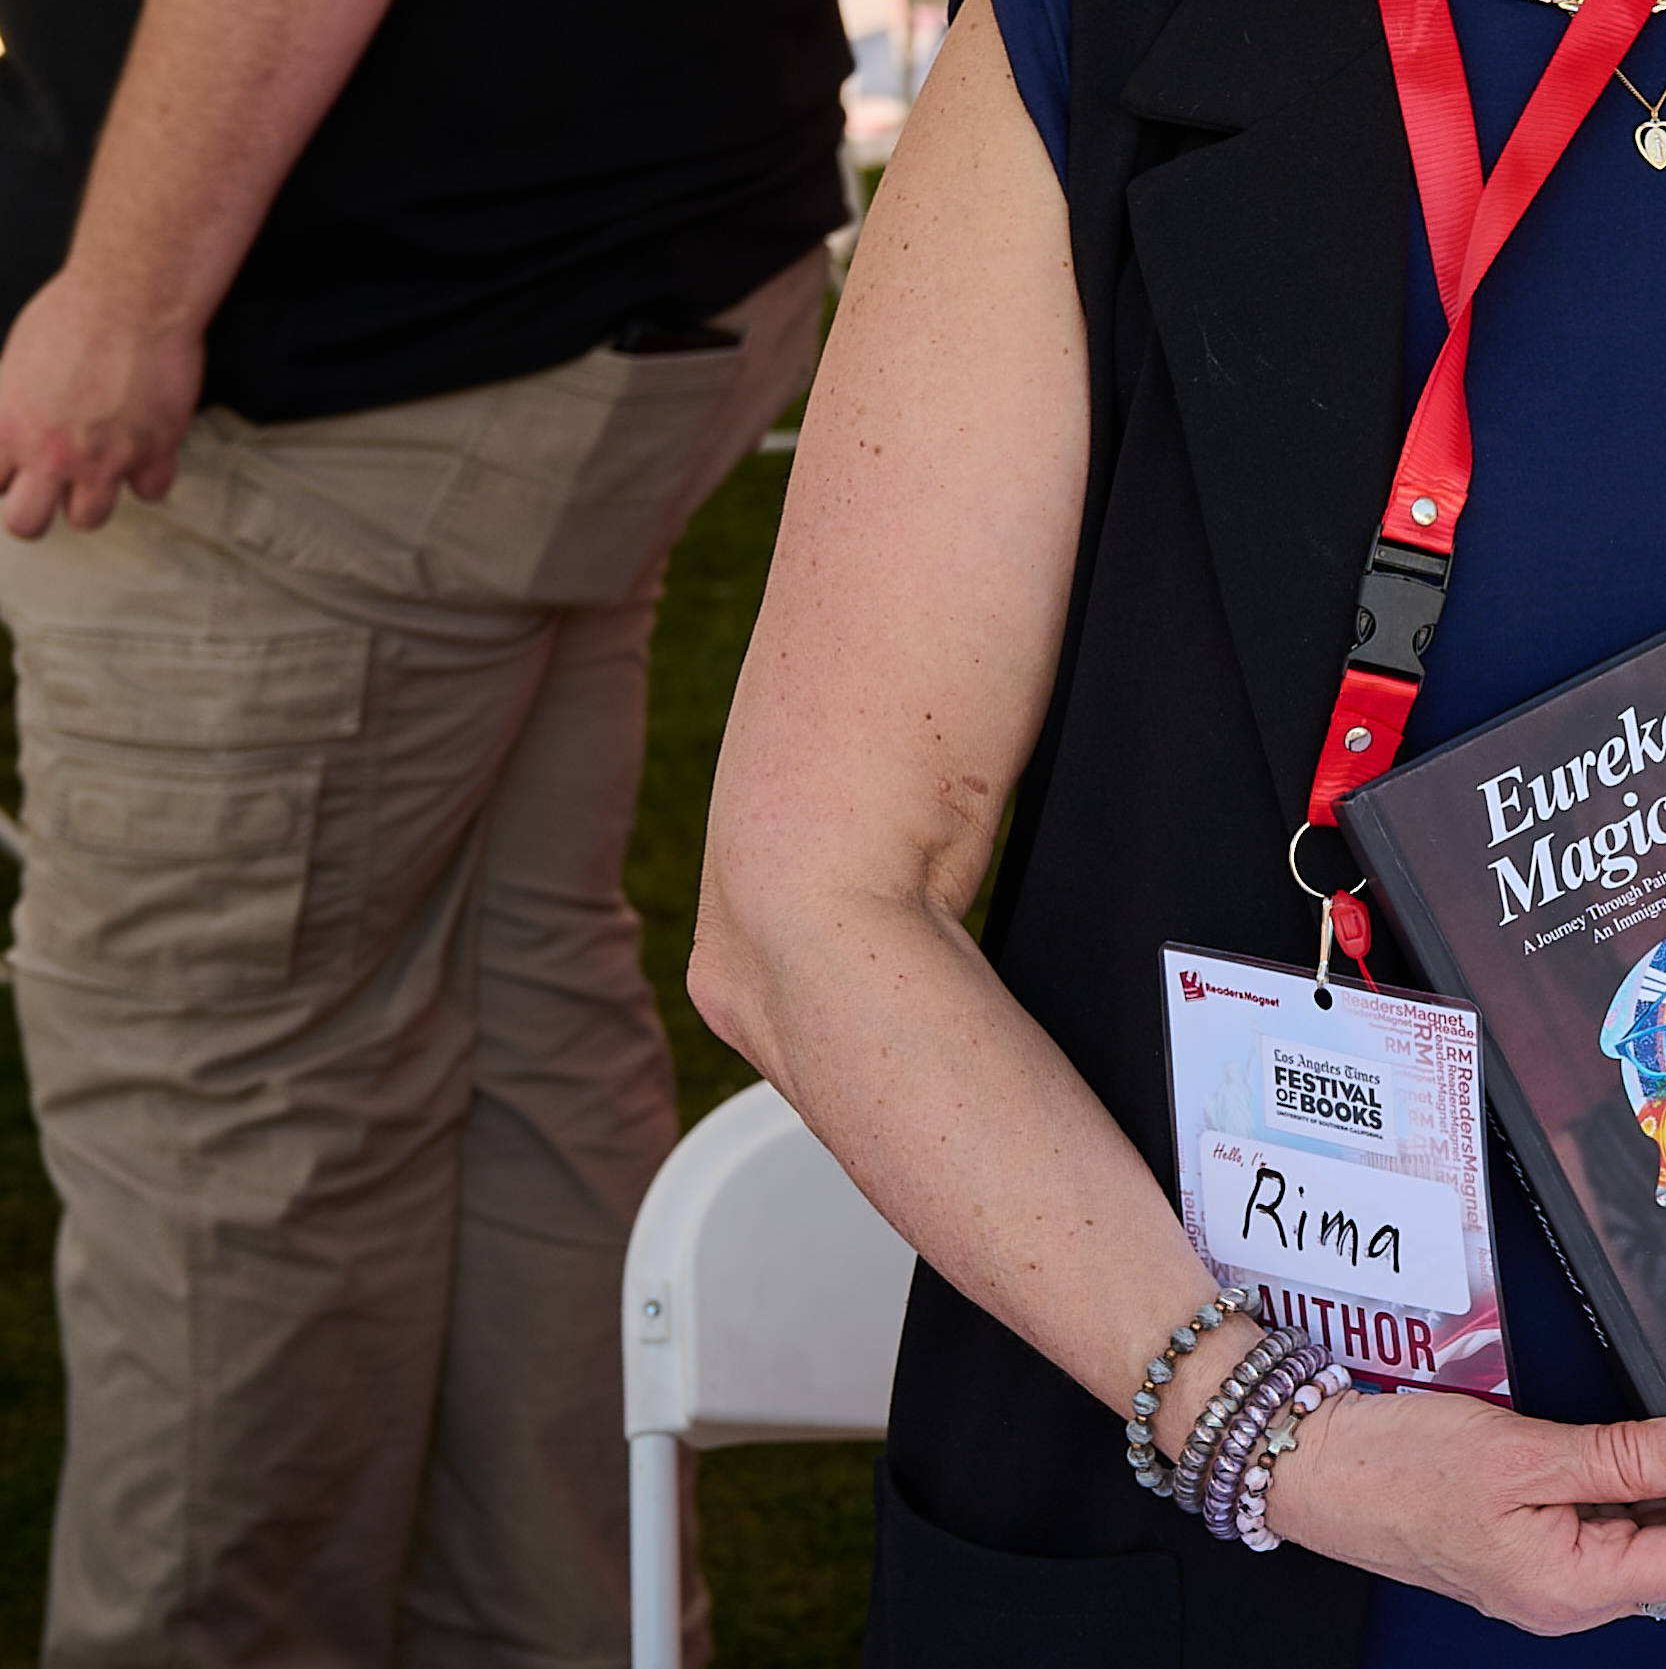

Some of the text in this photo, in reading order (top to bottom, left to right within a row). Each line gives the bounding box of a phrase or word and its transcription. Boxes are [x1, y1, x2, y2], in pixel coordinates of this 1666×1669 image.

[1523, 940, 1536, 955] A
[1536, 915, 1586, 948] Journey
[1586, 885, 1643, 920] Through
[1593, 927, 1614, 943] An
[1205, 983, 1280, 1007] ReadersMagnet
[1341, 990, 1465, 1027] ReadersMagnet
[1274, 1049, 1380, 1085] Los Angeles Times
[1446, 1046, 1473, 1065] RM
[1274, 1066, 1382, 1108] FESTIVAL
[1276, 1088, 1383, 1129] OF BOOKS
[1213, 1142, 1244, 1168] Hello,
[1458, 1067, 1482, 1231] ReadersMagnet
[1242, 1167, 1401, 1275] Rima
[1257, 1283, 1437, 1372] AUTHOR
